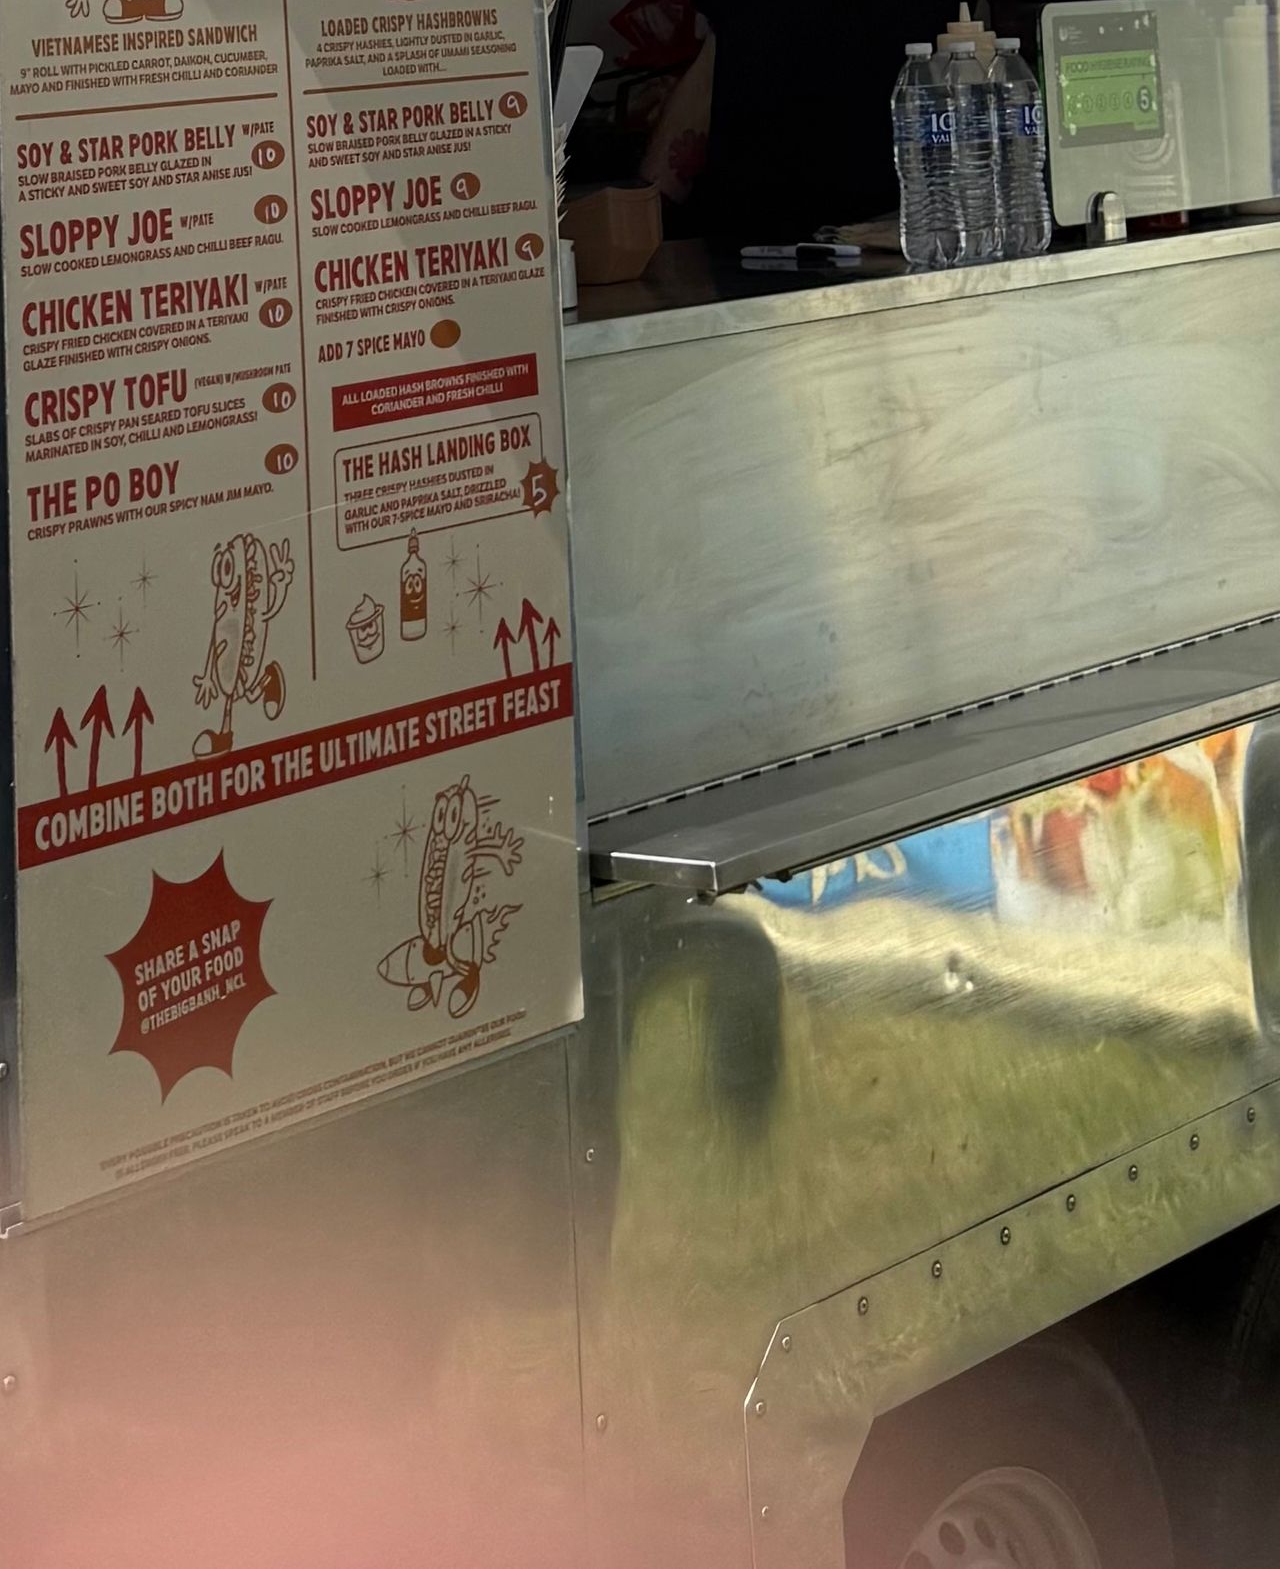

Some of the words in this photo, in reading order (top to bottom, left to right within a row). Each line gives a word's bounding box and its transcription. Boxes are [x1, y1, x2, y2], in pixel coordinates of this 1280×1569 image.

[31, 33, 118, 57] VIETNAMESE
[122, 29, 184, 51] INSPIRED
[187, 24, 257, 46] SANDWICH
[320, 17, 368, 37] LOADED
[371, 14, 413, 33] CRISPY
[416, 8, 497, 30] HASHBROWNS
[306, 113, 337, 138] SOY
[342, 111, 354, 135] &
[358, 107, 398, 133] STAR
[402, 103, 444, 128] PORK
[449, 99, 493, 124] BELLY
[505, 94, 521, 114] 9
[16, 142, 53, 169] SOY
[59, 139, 72, 165] &
[78, 135, 123, 163] STAR
[128, 129, 177, 157] PORK
[184, 124, 235, 151] BELLY
[257, 146, 276, 165] 10
[17, 172, 49, 187] SLOW
[50, 167, 96, 183] BRAISED
[97, 164, 126, 178] PORK
[128, 161, 158, 175] BELLY
[159, 156, 199, 171] GLAZED
[201, 155, 212, 167] IN
[18, 190, 26, 202] A
[28, 185, 65, 201] STICKY
[67, 183, 90, 196] AND
[91, 179, 127, 193] SWEET
[128, 176, 150, 189] SOY
[151, 173, 174, 187] AND
[174, 171, 200, 184] STAR
[201, 167, 231, 181] ANISE
[232, 165, 252, 178] JUS!
[455, 177, 469, 200] 9
[264, 201, 280, 222] 10
[310, 181, 394, 220] SLOPPY
[403, 175, 442, 209] JOE
[20, 215, 118, 259] SLOPPY
[127, 207, 172, 245] JOE
[521, 239, 535, 261] 9
[20, 262, 52, 277] SLOW
[53, 256, 99, 273] COOKED
[100, 247, 171, 266] LEMONGRASS
[173, 243, 195, 257] AND
[196, 239, 227, 254] CHILLI
[228, 236, 253, 250] BEEF
[254, 233, 283, 246] RAGU.
[314, 250, 408, 292] CHICKEN
[415, 237, 508, 277] TERIYAKI
[22, 289, 132, 335] CHICKEN
[140, 273, 247, 318] TERIYAKI
[268, 303, 284, 324] 10
[22, 339, 59, 356] CRISPY
[61, 335, 91, 350] FRIED
[92, 328, 137, 345] CHICKEN
[138, 321, 184, 338] COVERED
[185, 319, 196, 331] IN
[197, 318, 205, 329] A
[206, 311, 248, 327] TERIYAKI
[22, 355, 57, 372] GLAZE
[58, 349, 105, 366] FINISHED
[106, 344, 133, 358] WITH
[134, 339, 169, 354] CRISPY
[170, 332, 211, 348] ONIONS.
[318, 342, 343, 363] ADD
[345, 340, 354, 358] 7
[356, 334, 390, 356] SPICE
[393, 329, 425, 350] MAYO
[24, 380, 115, 426] CRISPY
[123, 369, 187, 410] TOFU
[272, 388, 291, 410] 10
[276, 452, 293, 471] 10
[342, 454, 373, 482] THE
[378, 445, 422, 475] HASH
[427, 432, 495, 465] LANDING
[499, 424, 531, 451] BOX
[26, 479, 76, 521] THE
[85, 472, 120, 510] PO
[129, 460, 178, 501] BOY
[529, 473, 547, 506] 5
[27, 523, 66, 541] CRISPY
[68, 513, 114, 533] PRAWNS
[115, 507, 143, 523] WITH
[144, 502, 167, 517] OUR
[169, 496, 198, 512] SPICY
[200, 491, 224, 506] NAM
[225, 487, 242, 501] JIM
[243, 481, 273, 497] MAYO.
[35, 791, 143, 849] COMBINE
[151, 772, 213, 819] BOTH
[220, 759, 265, 799] FOR
[271, 745, 313, 785] THE
[319, 717, 419, 771] ULTIMATE
[425, 696, 496, 743] STREET
[502, 679, 560, 721] FEAST
[135, 945, 185, 985] SHARE
[189, 940, 199, 961] A
[202, 920, 241, 954] SNAP
[139, 986, 157, 1012] OF
[161, 965, 202, 1000] YOUR
[205, 946, 244, 981] FOOD
